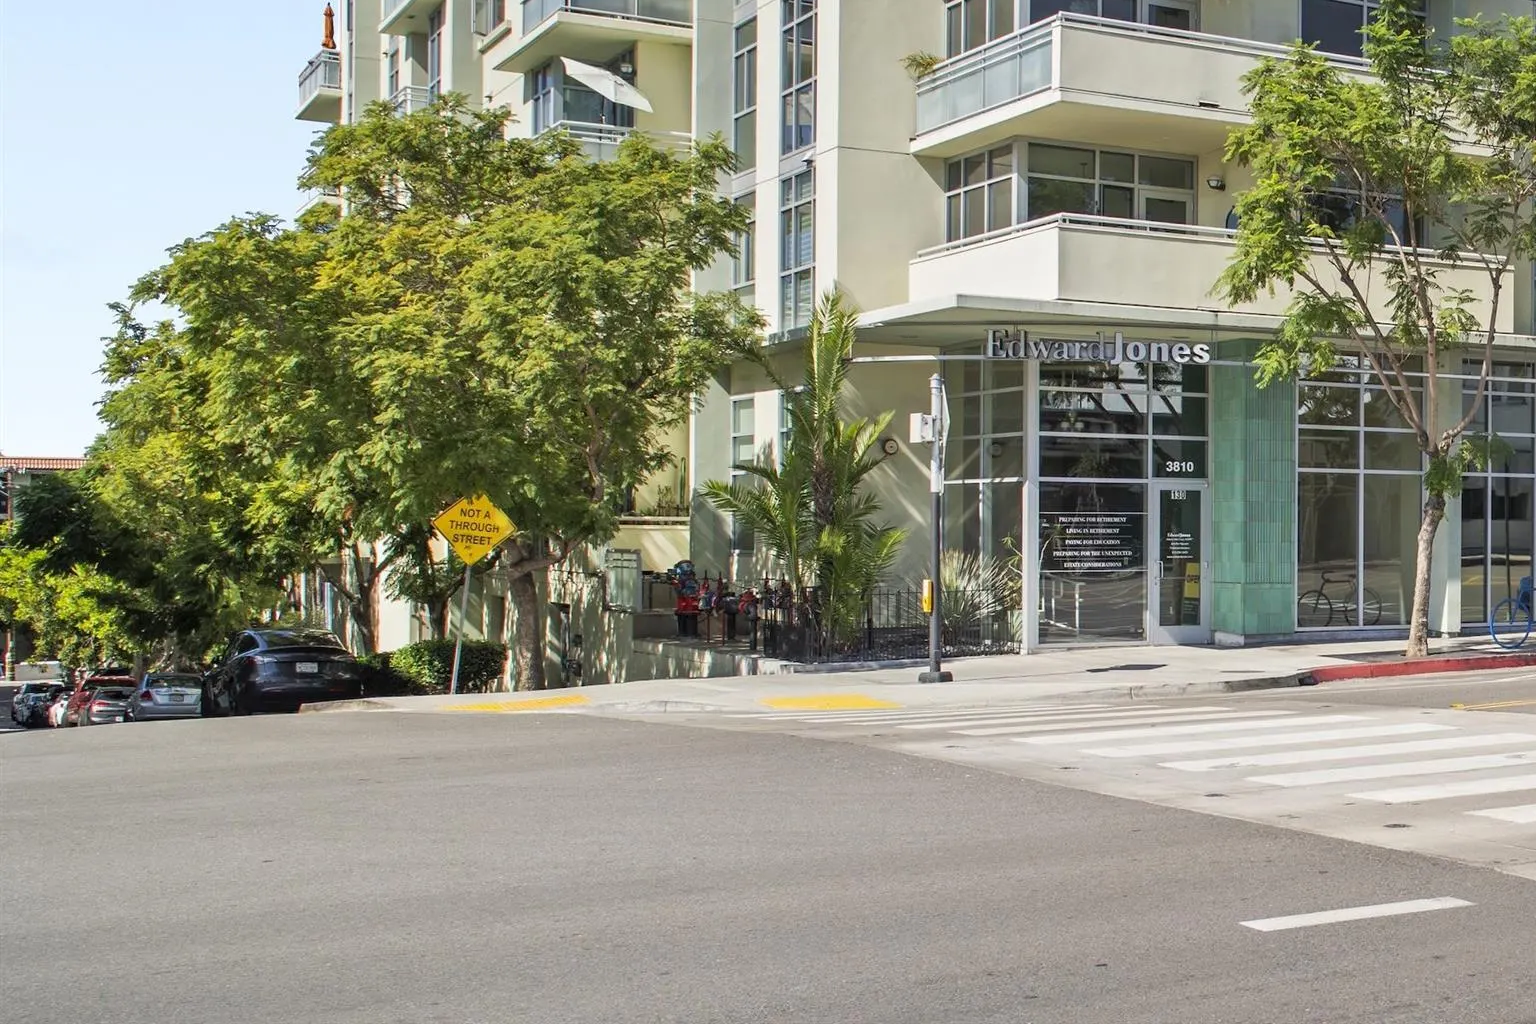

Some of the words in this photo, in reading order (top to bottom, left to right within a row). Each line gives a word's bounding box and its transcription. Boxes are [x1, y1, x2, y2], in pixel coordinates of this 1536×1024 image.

[1165, 461, 1194, 472] 3810
[460, 508, 482, 518] NOT
[484, 510, 491, 519] A
[449, 520, 500, 533] THROUGH
[452, 534, 492, 545] STREET
